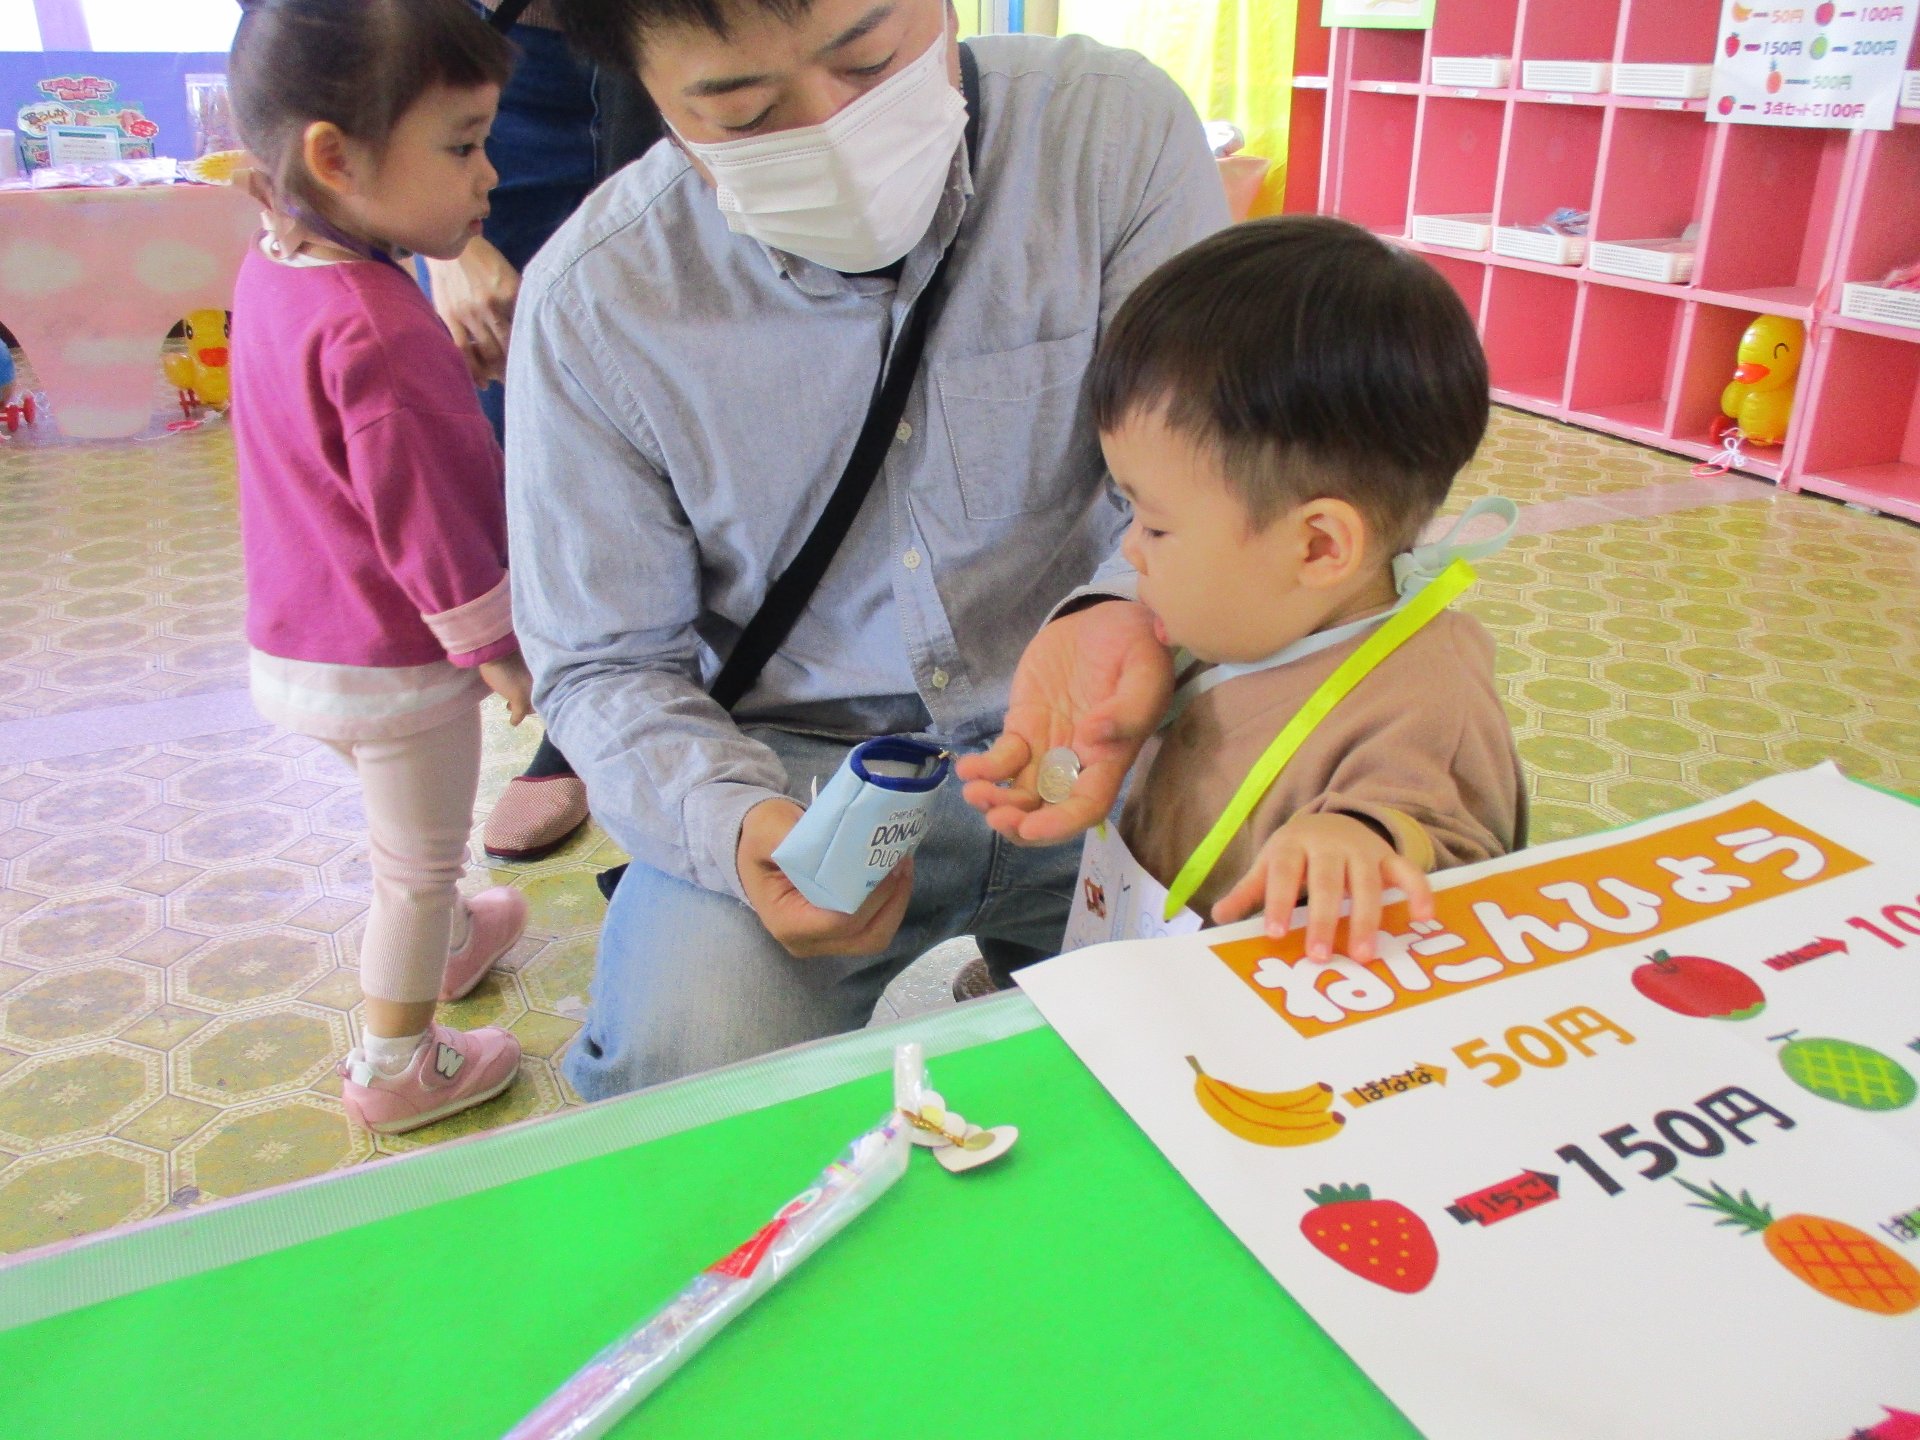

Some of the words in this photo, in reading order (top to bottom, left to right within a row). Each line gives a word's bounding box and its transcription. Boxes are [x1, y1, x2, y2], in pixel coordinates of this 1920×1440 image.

[1859, 5, 1904, 22] 100円
[1762, 40, 1804, 57] 150円
[1852, 39, 1898, 57] 200円
[1252, 825, 1828, 1025] ねだんひょう
[1845, 892, 1920, 949] 10
[1450, 1004, 1637, 1089] 50円
[1352, 1066, 1433, 1104] ばなな
[1555, 1084, 1797, 1198] 150円
